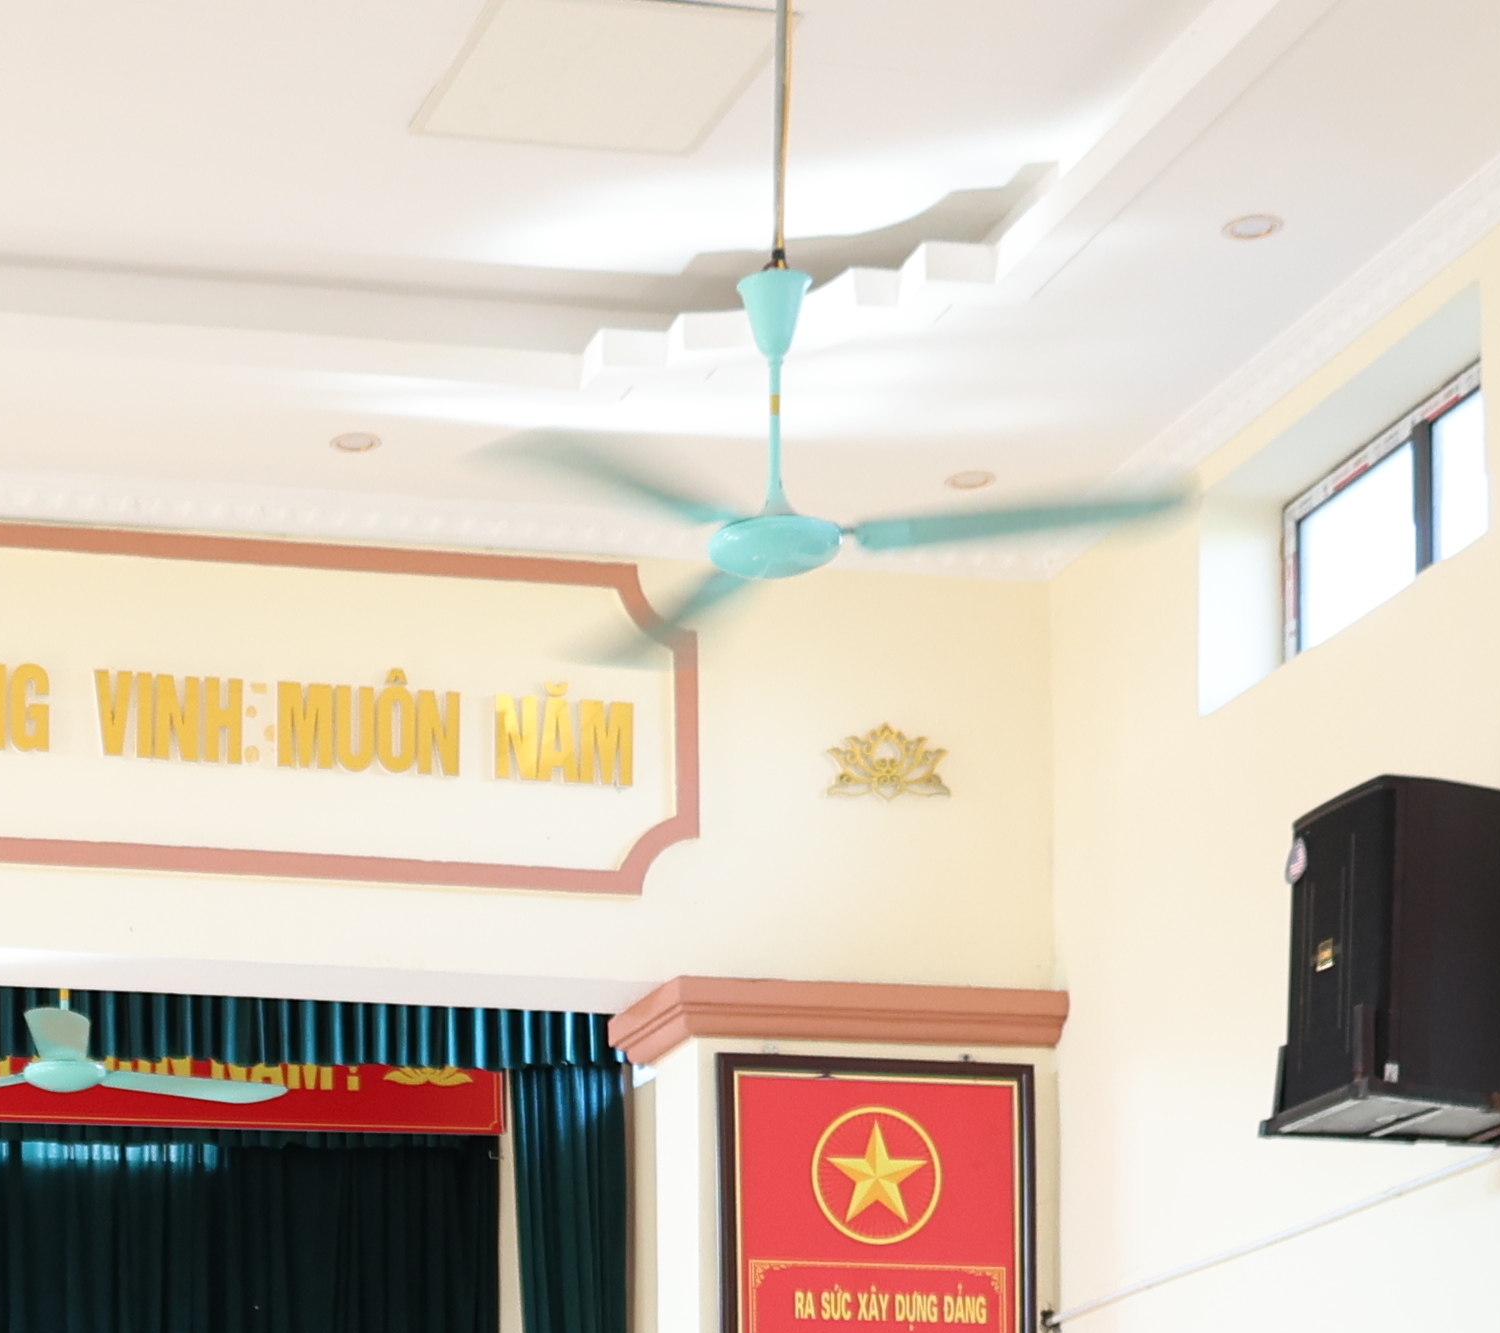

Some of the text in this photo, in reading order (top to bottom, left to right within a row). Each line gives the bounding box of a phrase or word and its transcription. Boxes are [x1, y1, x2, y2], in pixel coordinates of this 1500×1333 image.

[94, 669, 243, 764] VINH
[277, 668, 461, 777] MUÔN
[494, 681, 634, 787] NĂM
[794, 1283, 987, 1330] RA SỨC XÂY DỰNG ĐẢNG
